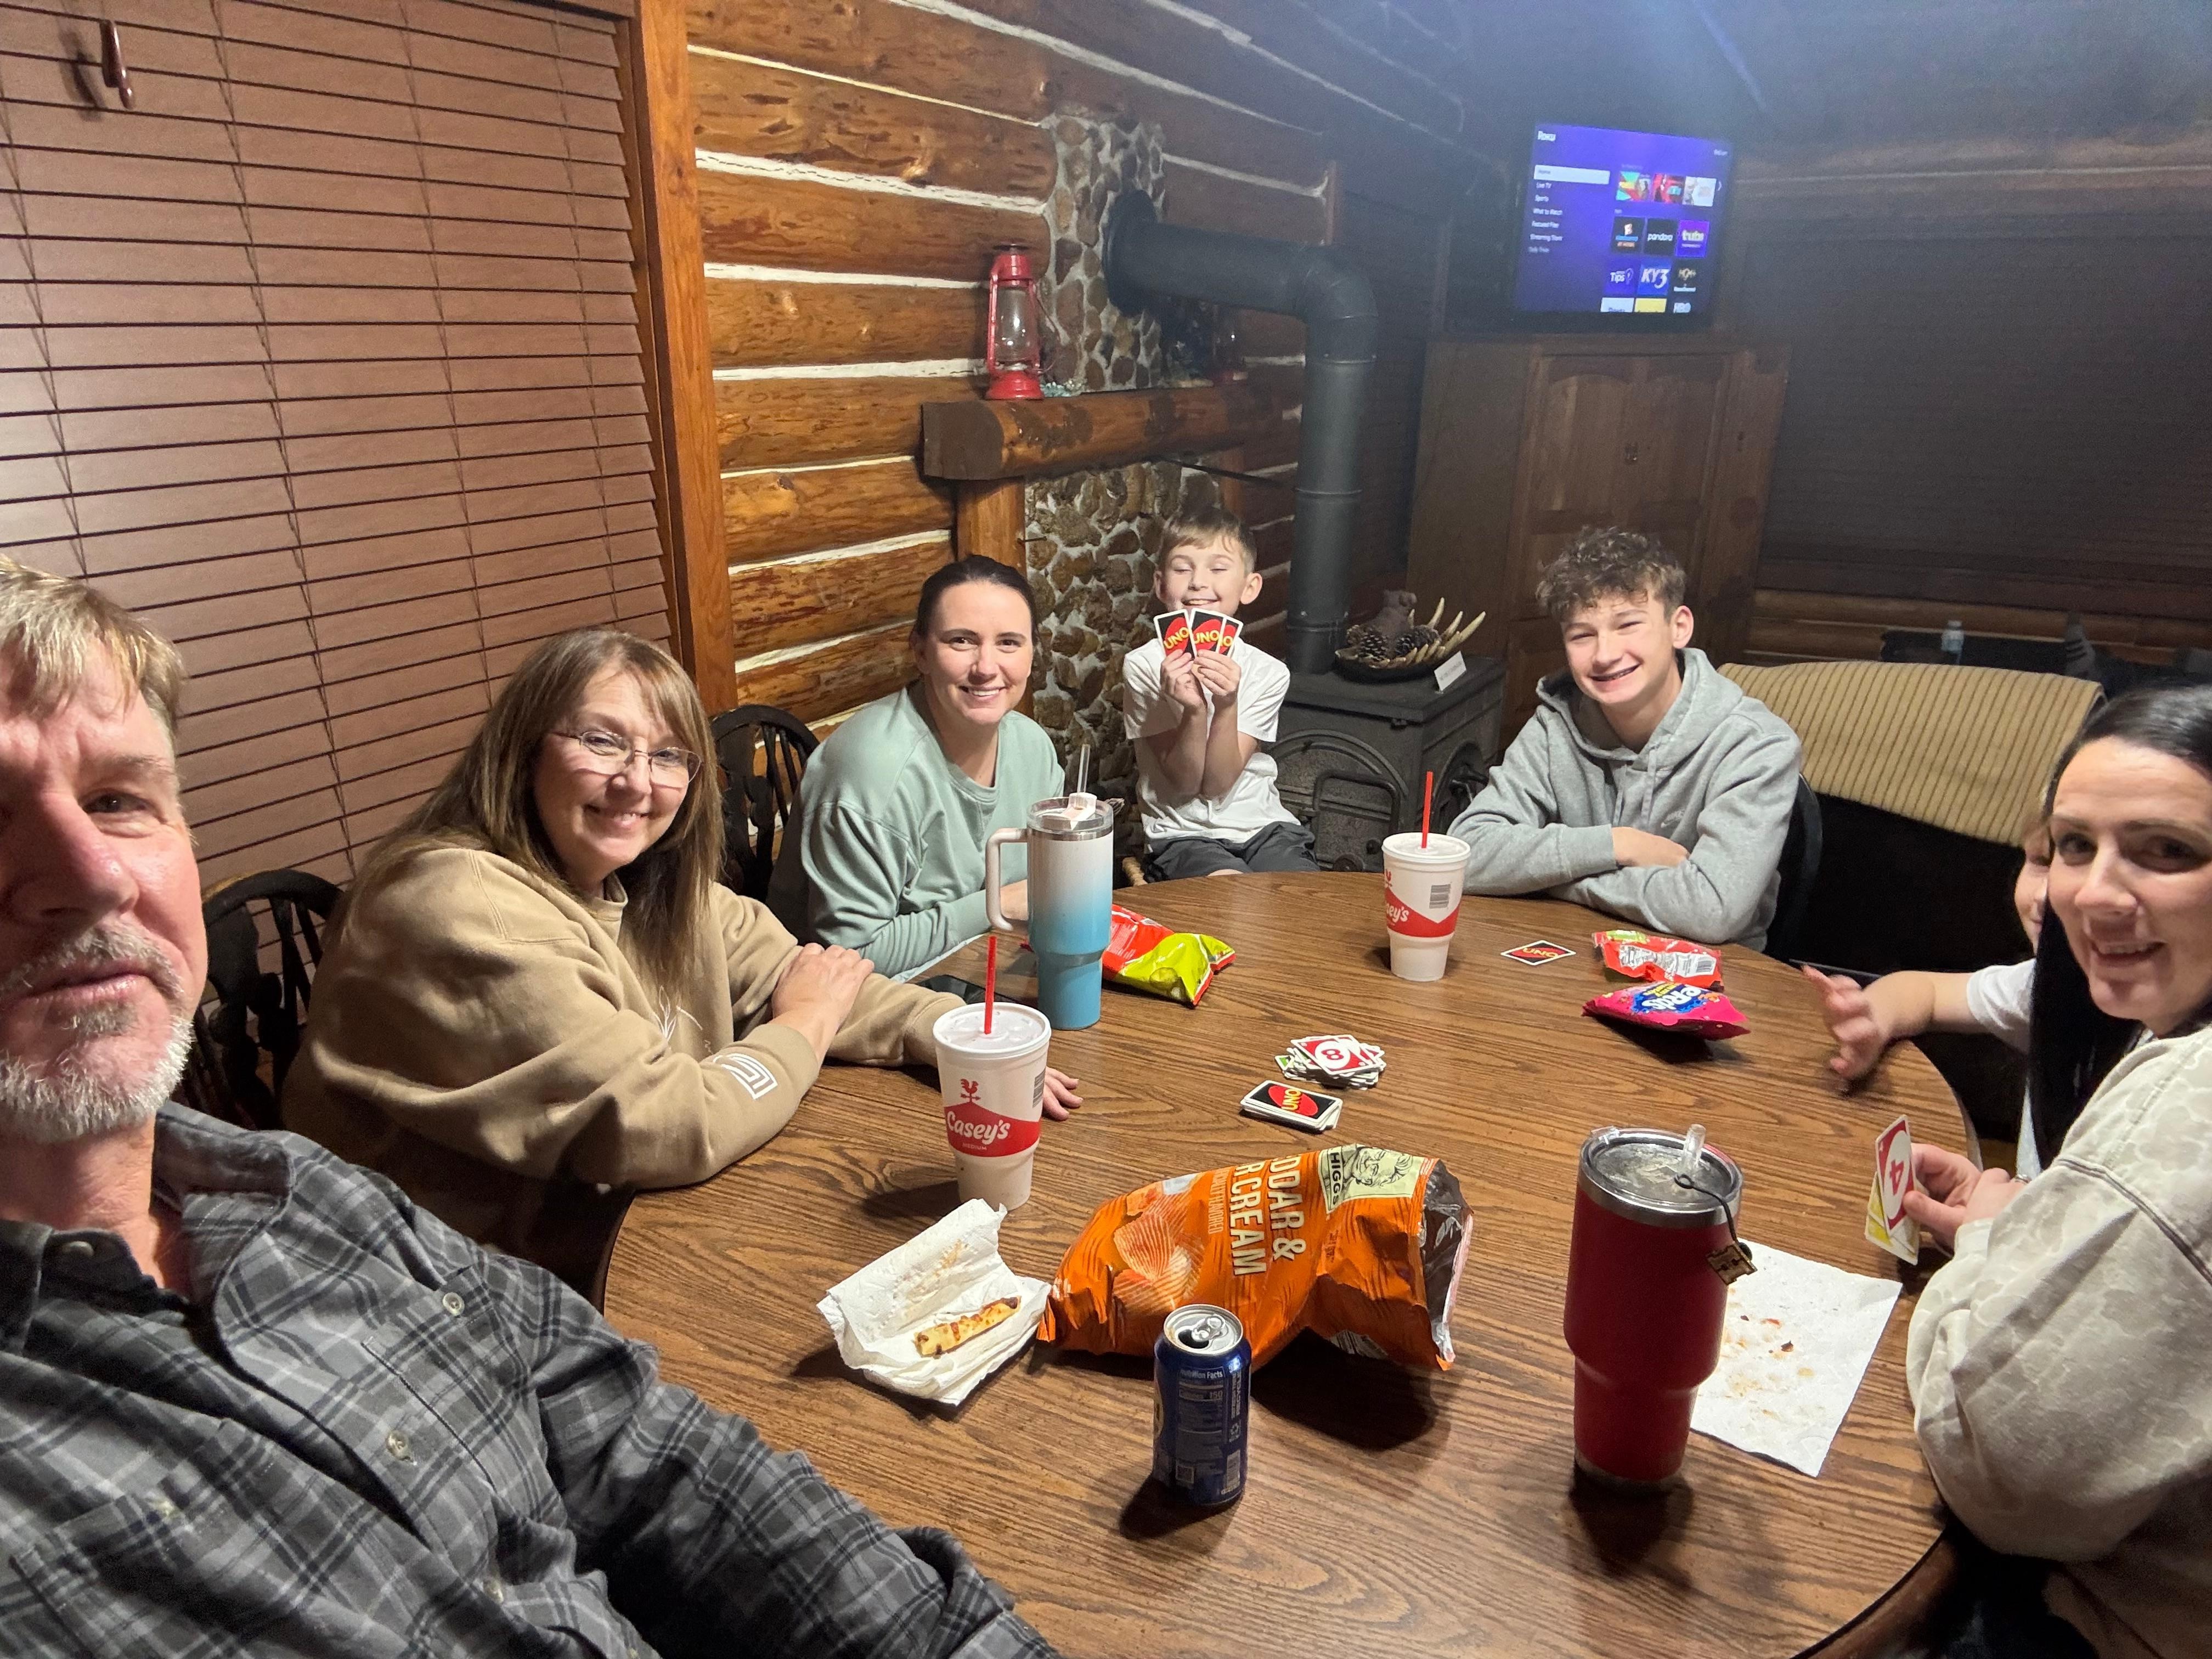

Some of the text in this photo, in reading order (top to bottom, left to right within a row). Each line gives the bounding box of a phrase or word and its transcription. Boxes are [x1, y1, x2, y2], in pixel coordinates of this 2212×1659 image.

[1647, 233, 1673, 242] pandora
[1641, 268, 1671, 289] KY3
[1163, 627, 1189, 650] UNO
[1193, 630, 1220, 644] UNO
[1386, 903, 1409, 923] ey's
[1522, 947, 1559, 958] UNO
[1321, 1048, 1344, 1060] 8
[1281, 1088, 1301, 1110] UNO
[946, 1110, 1011, 1145] Casey's
[1330, 1152, 1341, 1205] HIGGS
[1889, 1159, 1904, 1196] 4
[1208, 1195, 1225, 1235] FLAVORED
[1268, 1154, 1307, 1261] DDAR &
[1230, 1176, 1266, 1276] CREAM
[1207, 1370, 1223, 1379] Facts
